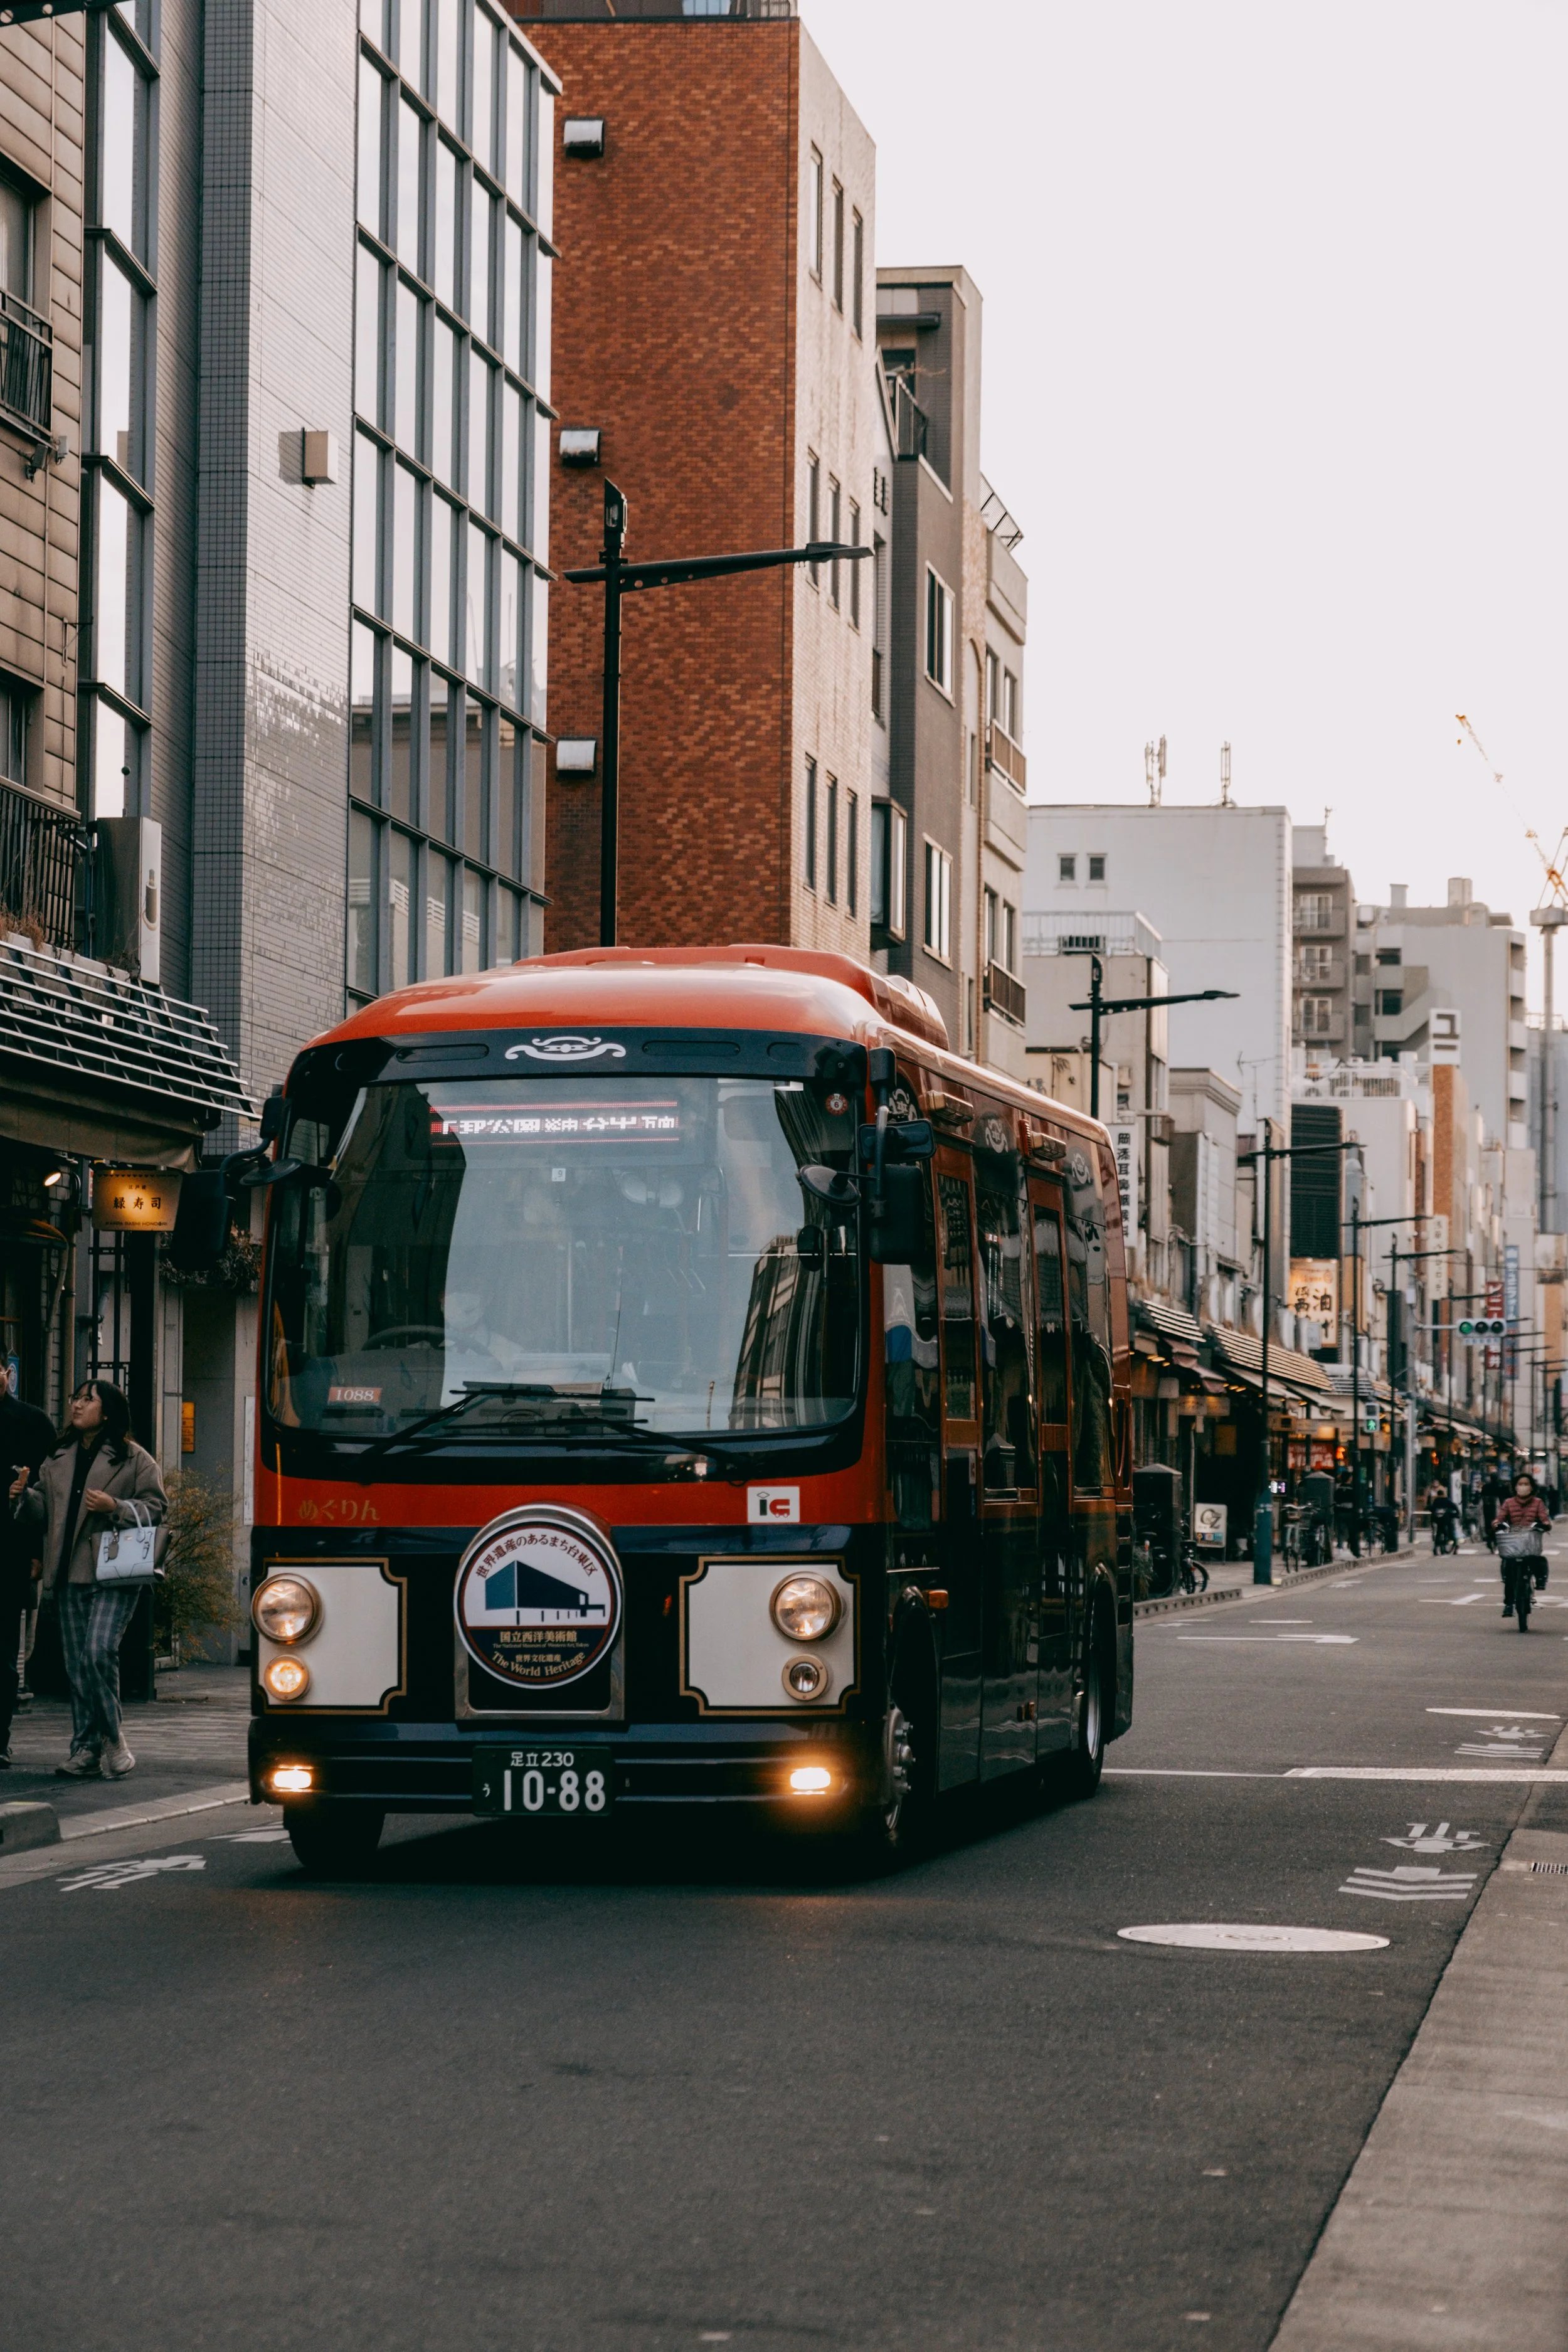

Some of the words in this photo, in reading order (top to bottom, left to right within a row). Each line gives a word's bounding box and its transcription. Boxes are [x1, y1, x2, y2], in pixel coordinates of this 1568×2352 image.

[336, 1389, 374, 1401] 1088
[298, 1500, 380, 1521] めぐりん
[476, 1533, 598, 1579] 世界遺産のあるまち台東区
[500, 1631, 578, 1643] 国立西洋美術館
[492, 1651, 509, 1668] The
[511, 1661, 541, 1677] World
[545, 1651, 586, 1677] Heritage
[516, 1654, 561, 1663] 世界文化遺産
[482, 1783, 490, 1798] う
[504, 1770, 606, 1811] 10-88
